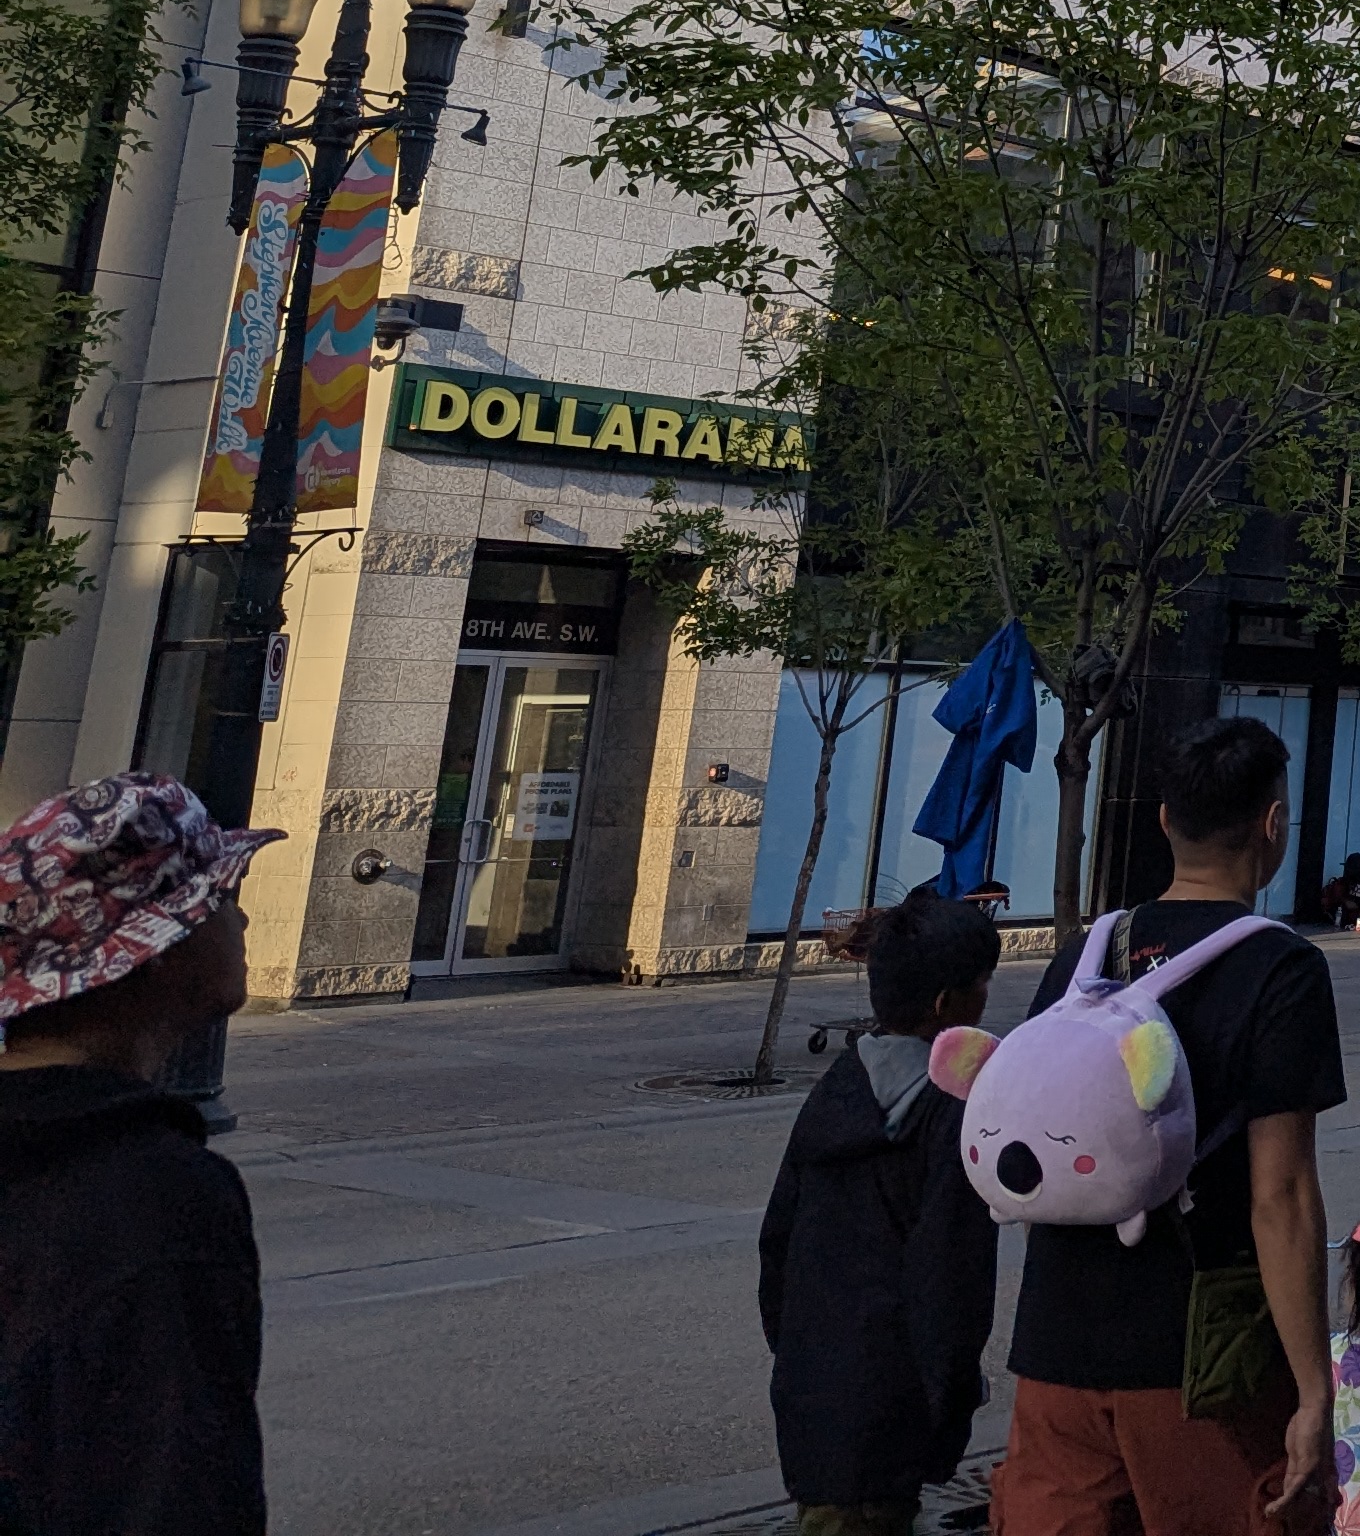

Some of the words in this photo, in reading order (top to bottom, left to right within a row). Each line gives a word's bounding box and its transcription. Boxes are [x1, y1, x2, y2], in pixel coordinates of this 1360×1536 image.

[253, 200, 288, 324] Stephen
[241, 291, 275, 407] Avenue
[216, 353, 247, 453] Walk
[418, 380, 811, 472] DOLLARAMA
[466, 620, 504, 637] 8TH
[511, 622, 550, 640] AVE.
[559, 624, 598, 642] S.W.
